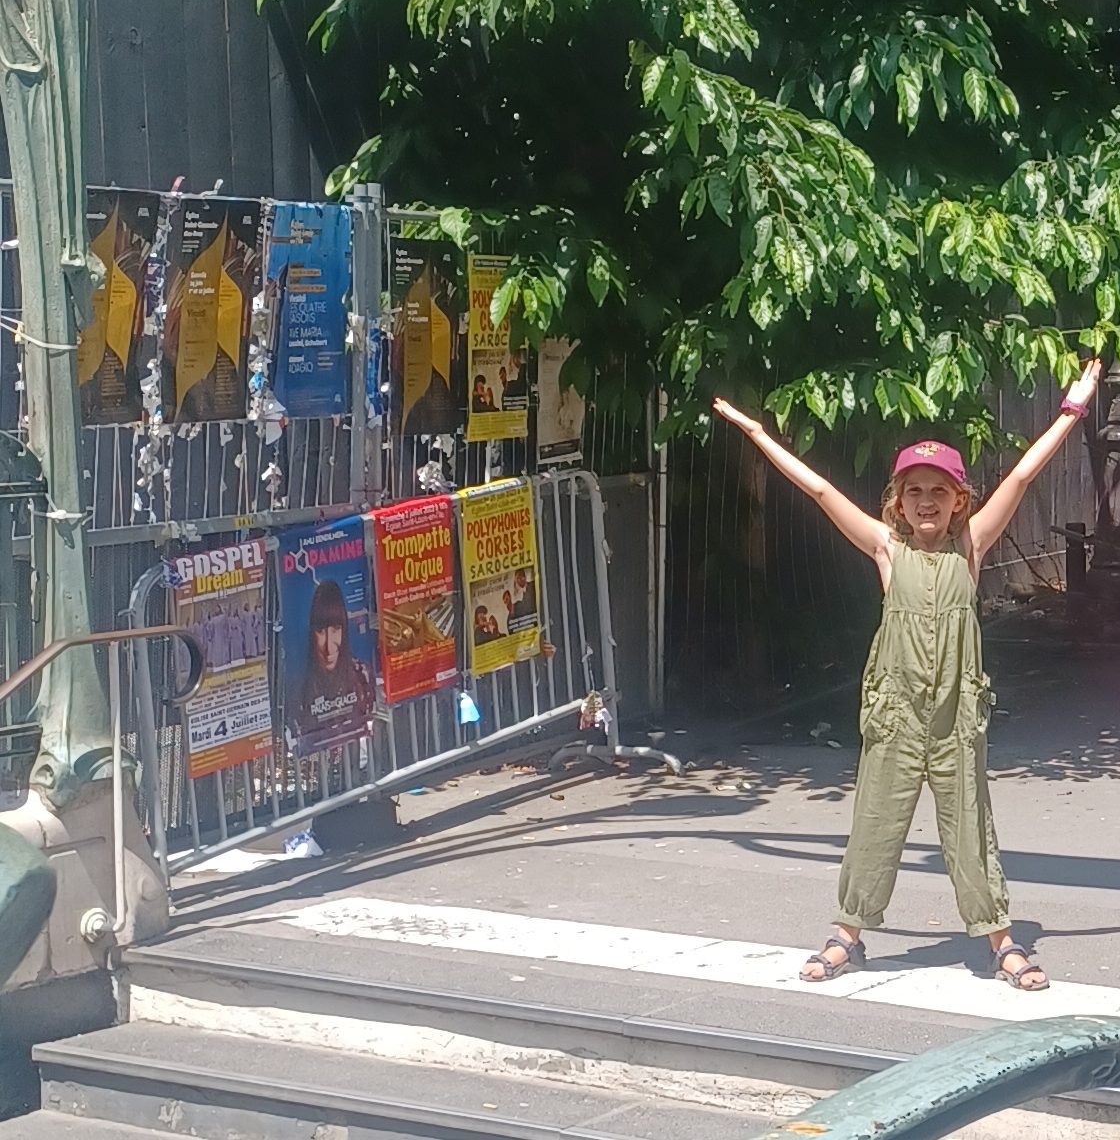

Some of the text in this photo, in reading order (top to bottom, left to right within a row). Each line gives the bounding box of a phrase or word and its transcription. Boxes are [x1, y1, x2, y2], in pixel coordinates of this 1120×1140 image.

[466, 507, 531, 540] POLYPHONIES
[382, 526, 450, 560] Trompette
[477, 529, 525, 561] CORSES
[176, 542, 264, 582] GOSPEL
[404, 556, 443, 583] Orgue
[470, 550, 533, 579] SAROCCHI
[196, 569, 244, 593] Dream
[192, 727, 212, 743] Mardi
[214, 721, 228, 736] 4
[231, 715, 258, 730] Juillet
